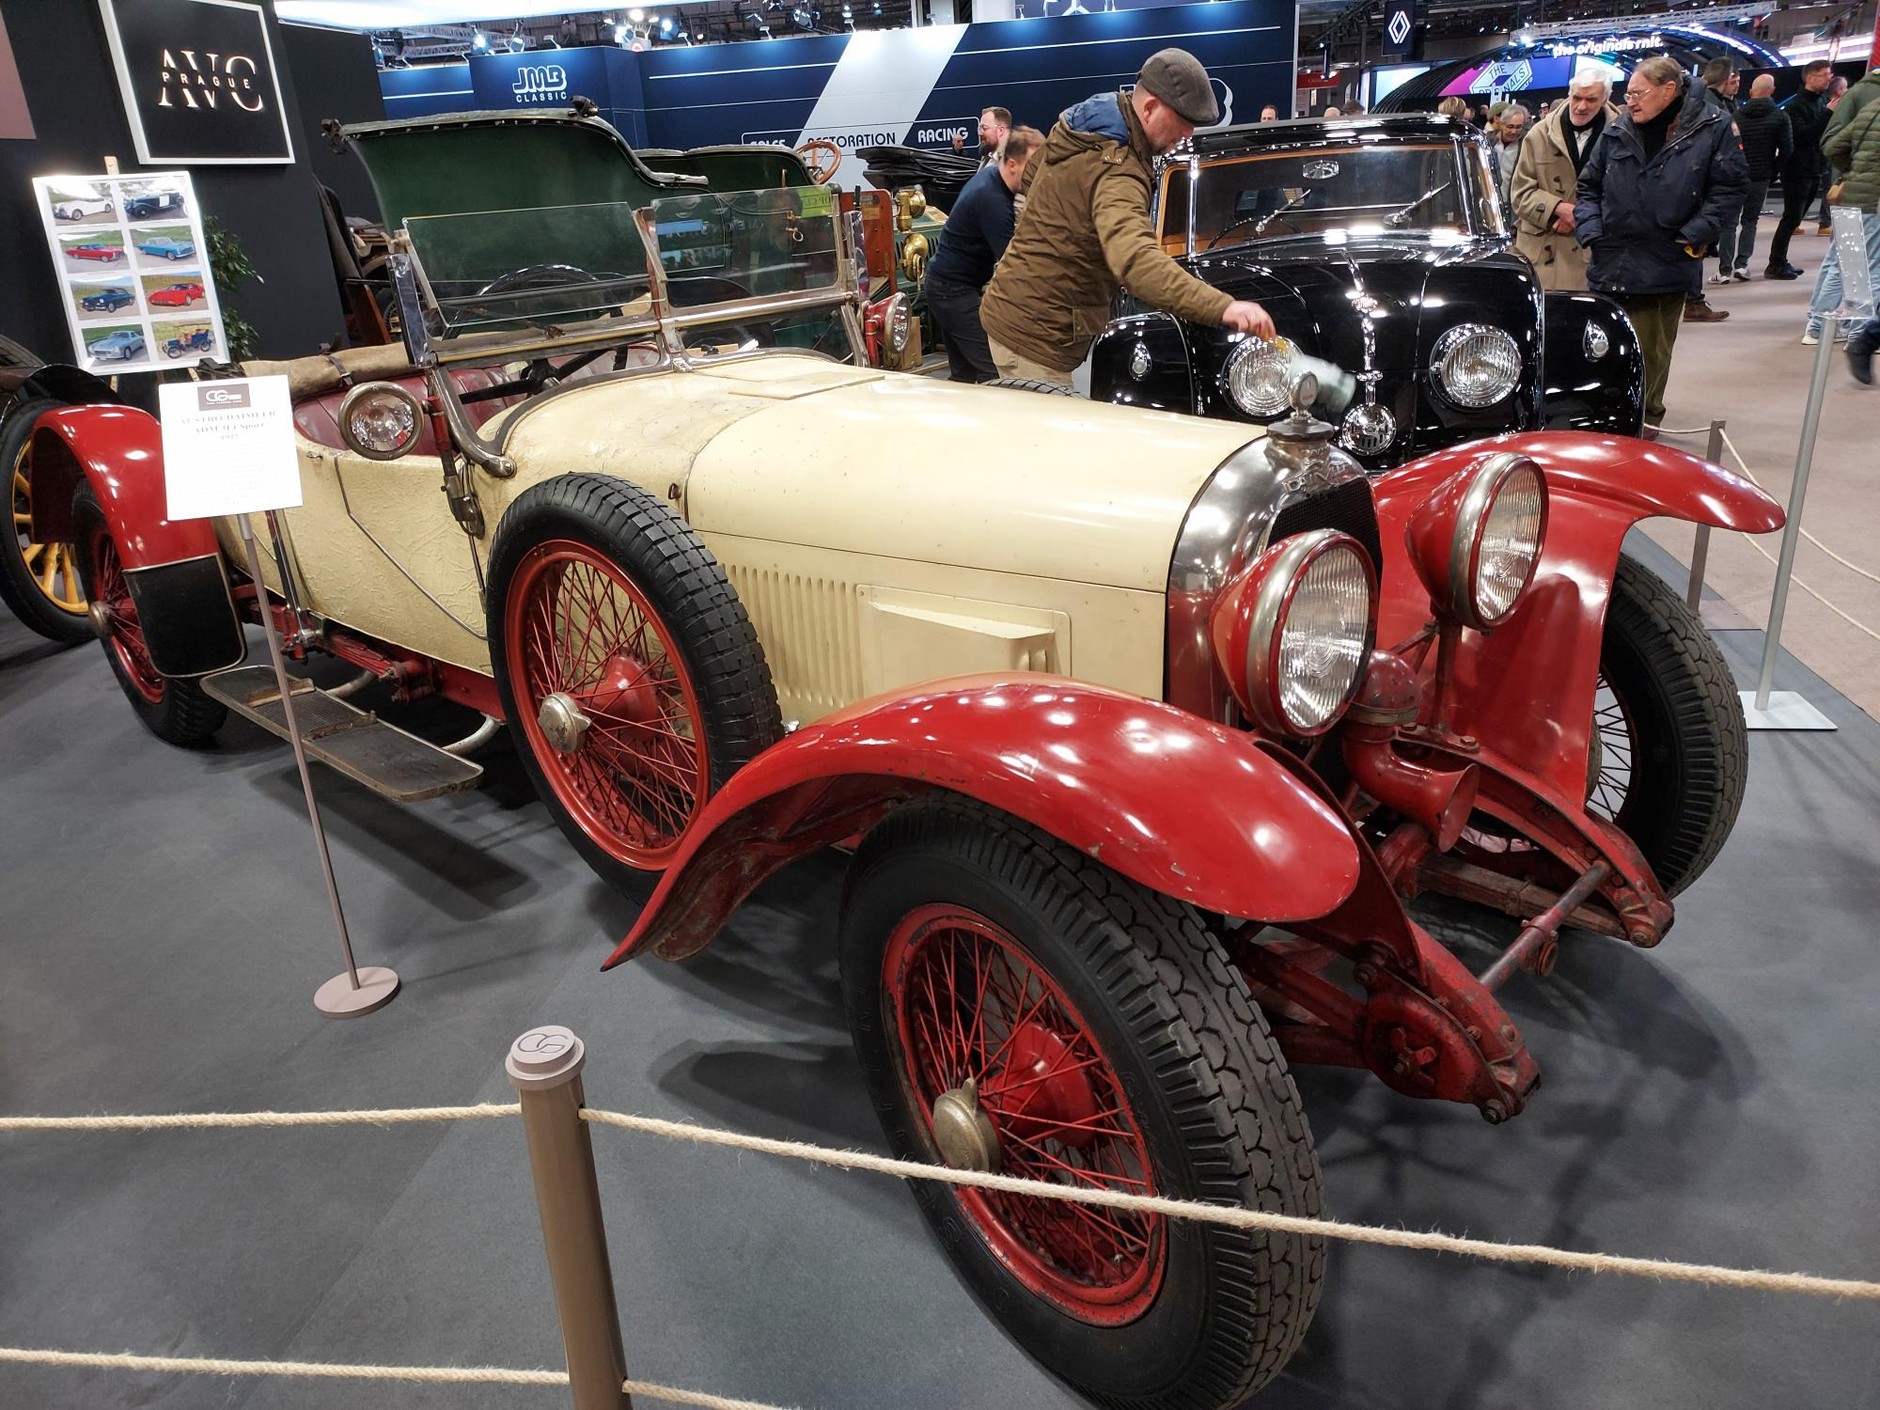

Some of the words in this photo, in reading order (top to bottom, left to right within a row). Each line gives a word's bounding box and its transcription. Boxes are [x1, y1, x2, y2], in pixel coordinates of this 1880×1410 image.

[1553, 41, 1574, 58] the
[161, 71, 251, 89] PRAGUE
[512, 64, 568, 94] JMB
[516, 91, 567, 103] CLASSIC
[917, 127, 969, 143] RACING
